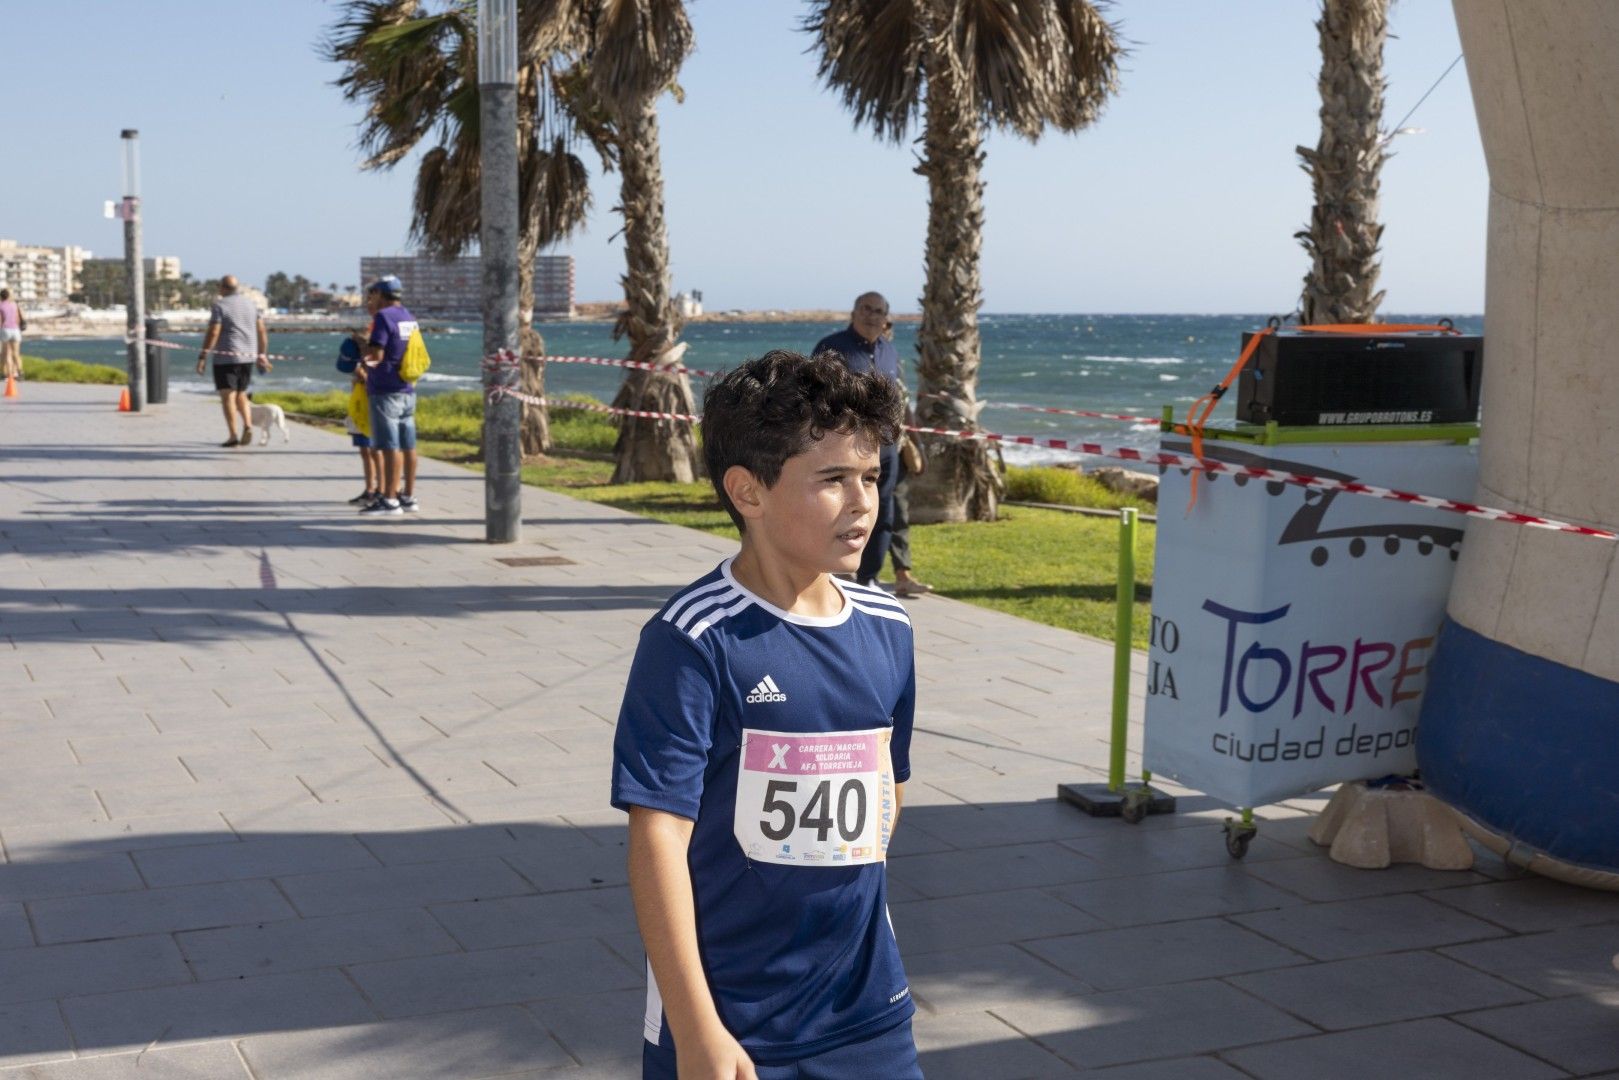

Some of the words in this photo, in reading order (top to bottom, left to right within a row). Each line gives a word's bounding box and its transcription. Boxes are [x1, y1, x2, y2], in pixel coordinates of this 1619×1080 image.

[1147, 660, 1179, 700] JA
[746, 691, 787, 704] adidas
[767, 743, 791, 770] X
[815, 752, 851, 762] SOLIDARIA
[1211, 727, 1326, 763] ciudad
[800, 763, 817, 771] AFA
[819, 761, 863, 770] TORREVIEJA
[759, 778, 867, 842] 540
[881, 770, 891, 853] INFANTIL
